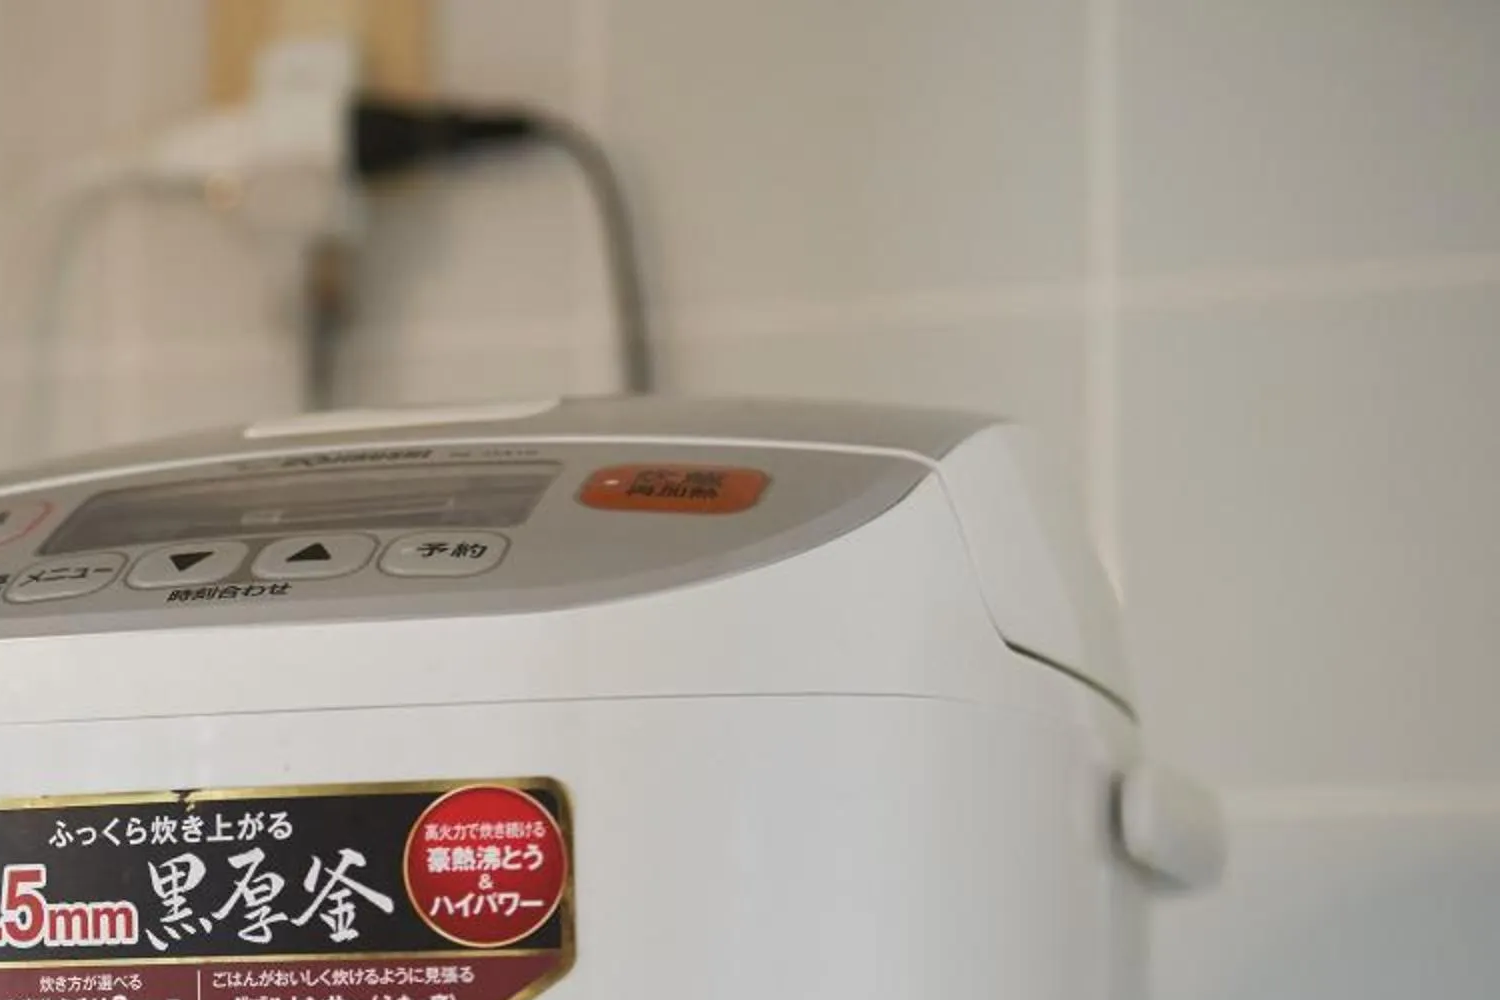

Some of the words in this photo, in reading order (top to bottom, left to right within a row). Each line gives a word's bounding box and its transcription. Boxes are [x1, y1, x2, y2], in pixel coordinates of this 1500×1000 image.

[417, 541, 488, 559] 予約
[18, 566, 113, 587] メニュー
[166, 581, 292, 602] 時刻合わせ
[48, 811, 294, 848] ふっくら炊き上がる
[478, 873, 494, 890] &
[144, 847, 396, 951] 黒厚釜
[429, 891, 545, 918] ハイパワー
[39, 974, 143, 993] 炊き方が選べる
[212, 966, 475, 989] ごはんがおいしく炊けるように見張る
